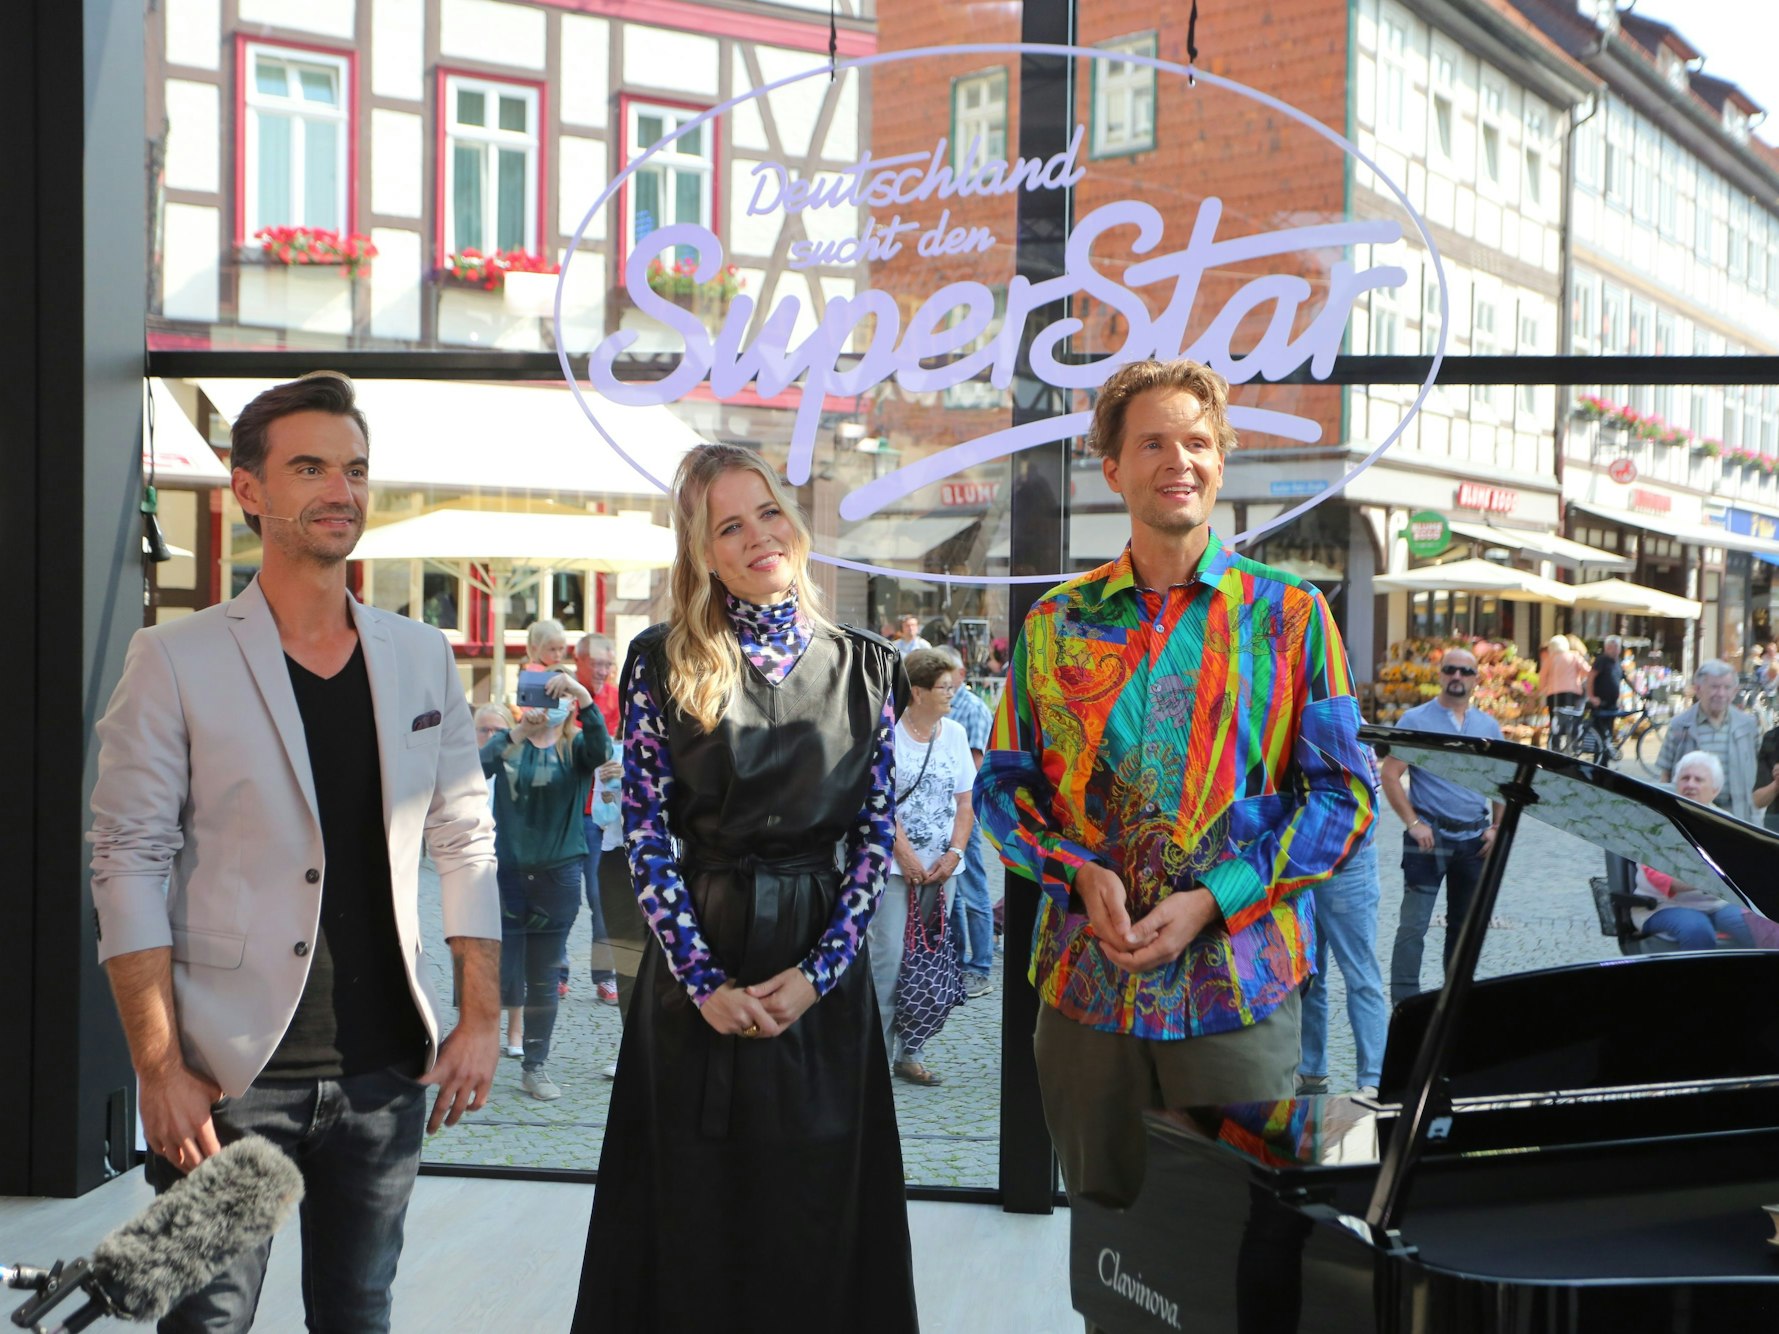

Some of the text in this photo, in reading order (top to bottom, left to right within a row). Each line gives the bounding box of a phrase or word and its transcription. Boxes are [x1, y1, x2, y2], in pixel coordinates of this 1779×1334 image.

[746, 123, 1086, 217] Deutschland
[788, 208, 996, 270] sucht den
[588, 196, 1406, 487] SuperStar
[1097, 1247, 1179, 1329] Clavinova
